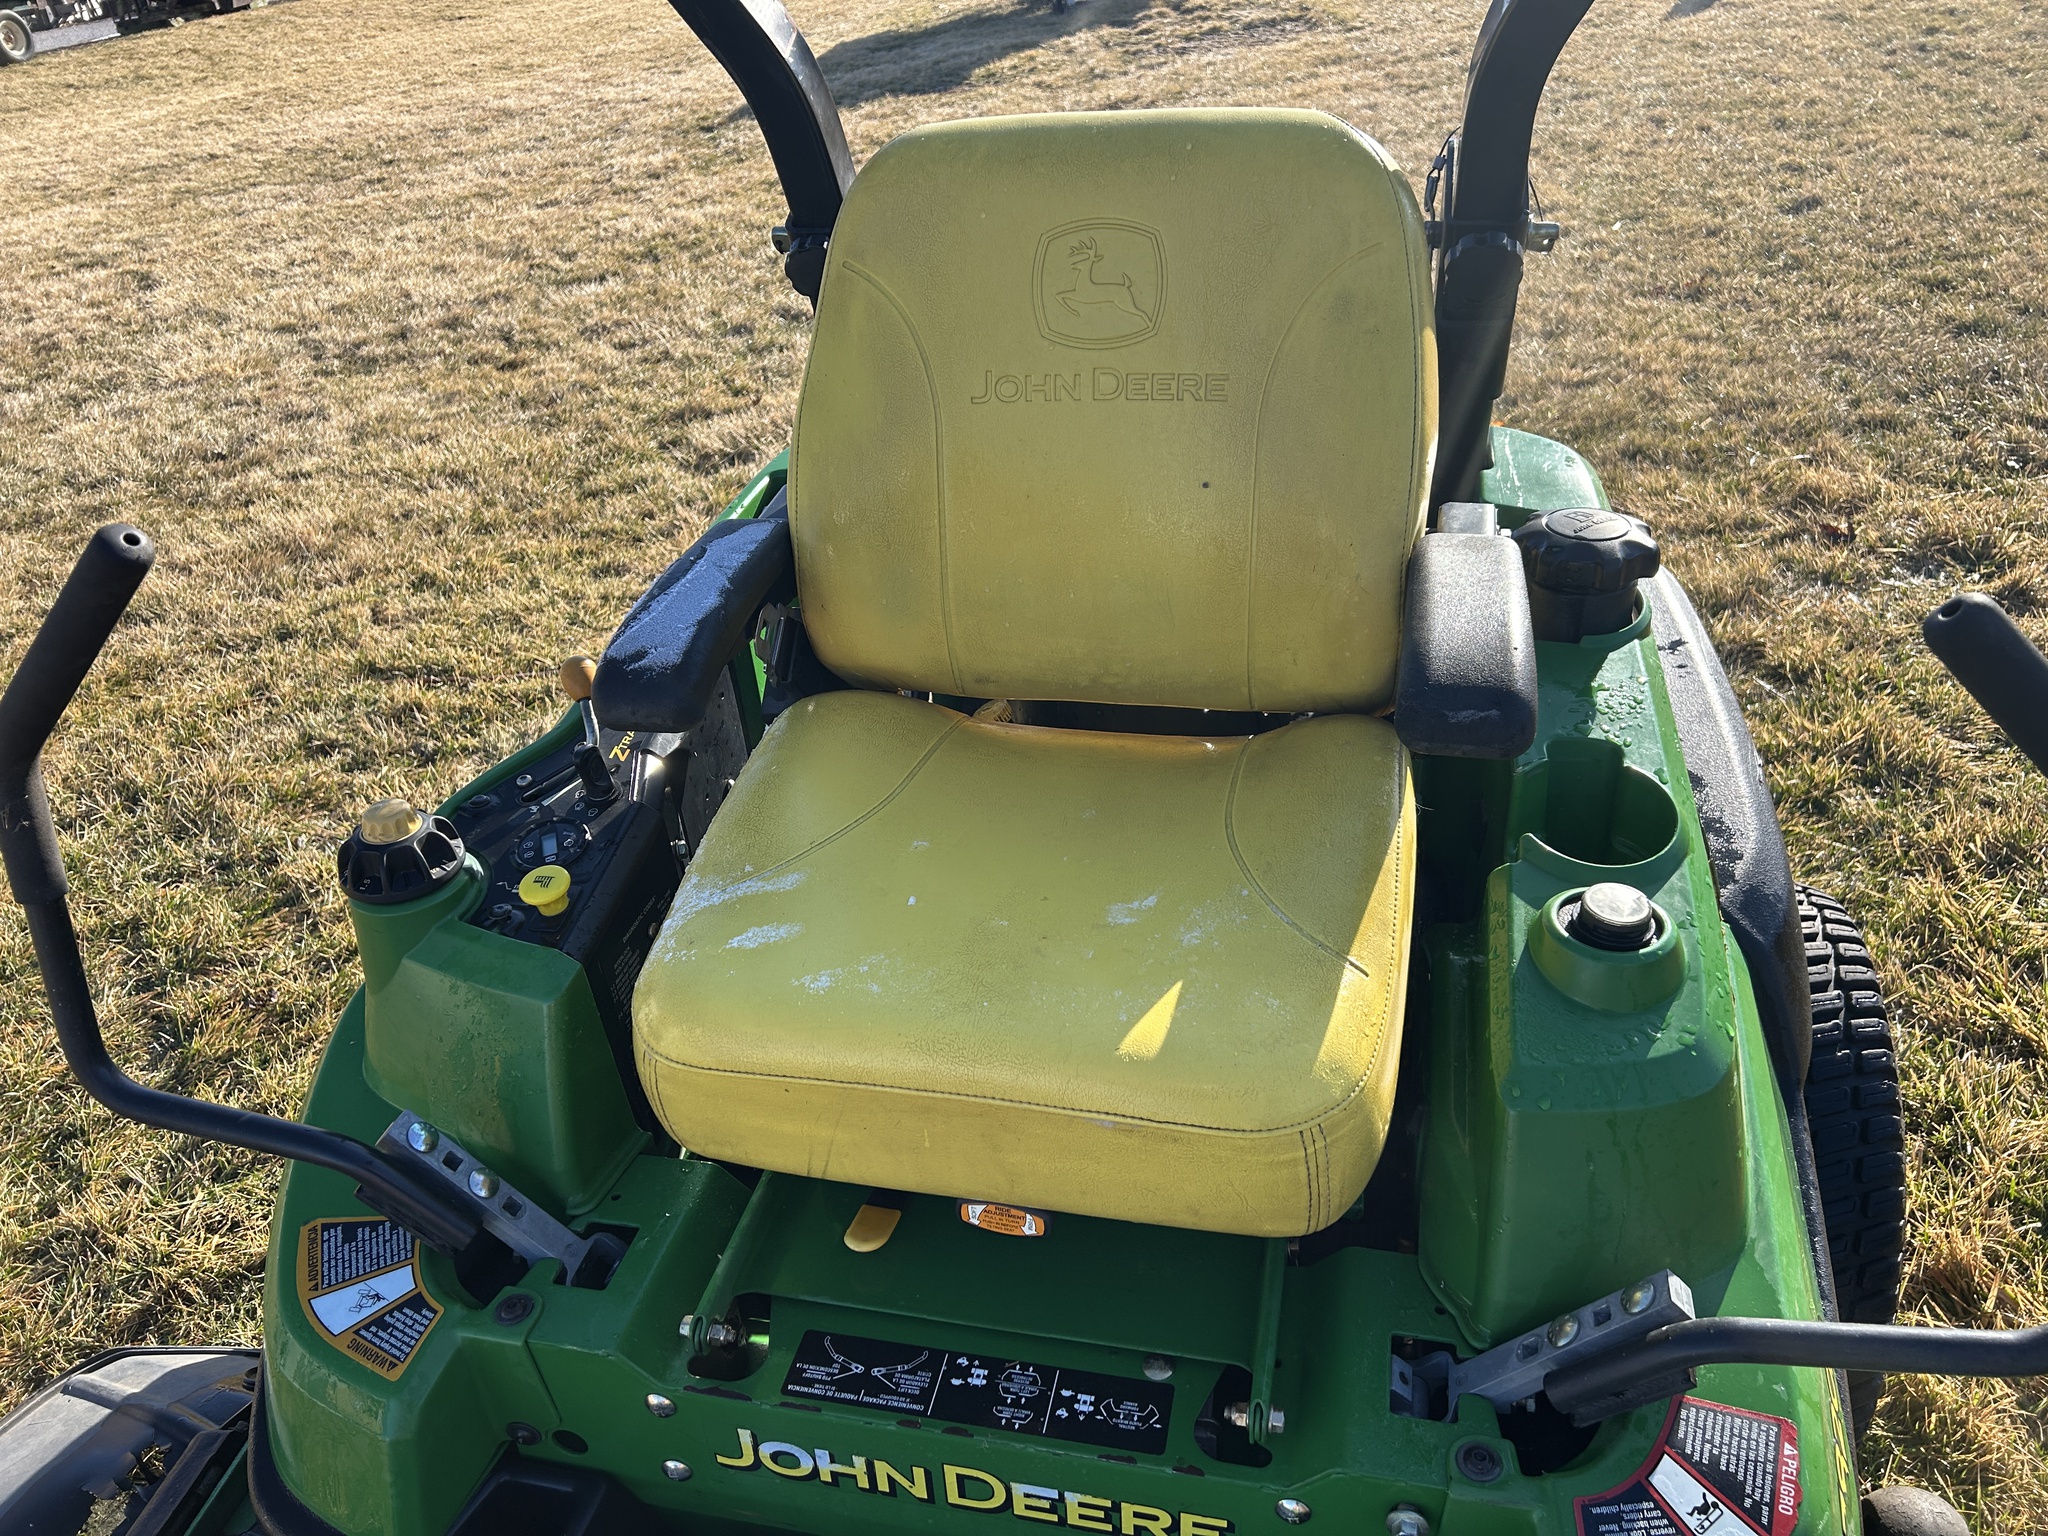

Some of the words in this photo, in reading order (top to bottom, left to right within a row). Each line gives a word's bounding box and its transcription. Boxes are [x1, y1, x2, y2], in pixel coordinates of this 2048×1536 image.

[971, 370, 1081, 404] JOHN
[1093, 367, 1229, 402] DEERE
[609, 731, 635, 762] ZTRA
[984, 1209, 1025, 1221] ADJUSTMENT
[995, 1206, 1011, 1214] RIDE
[308, 1225, 318, 1281] ADVERTENCIA
[347, 1338, 387, 1369] WARNING
[787, 1384, 825, 1395] CONVENIENCIA
[835, 1390, 858, 1400] PAQUETE
[862, 1396, 887, 1405] PACKAGE
[888, 1399, 925, 1411] CONVENIENCE
[1680, 1409, 1688, 1419] los
[1698, 1409, 1706, 1428] llevar
[1685, 1407, 1696, 1454] especialmente
[1714, 1413, 1723, 1447] retroceder
[1723, 1416, 1732, 1444] mientras
[1733, 1417, 1742, 1436] Mirar
[1769, 1425, 1777, 1441] Para
[1693, 1428, 1702, 1461] pasajeros,
[1722, 1444, 1728, 1454] se
[1731, 1436, 1740, 1454] hacia
[1740, 1440, 1747, 1448] en
[1750, 1440, 1756, 1449] en
[1758, 1431, 1766, 1461] segadora
[1767, 1442, 1775, 1461] evitar
[1702, 1443, 1711, 1464] Nunca
[1749, 1450, 1757, 1460] las
[1720, 1454, 1729, 1470] hace
[1737, 1449, 1746, 1481] retroceso.
[1766, 1462, 1774, 1473] las
[715, 1428, 927, 1499] JOHN
[942, 1463, 1230, 1536] DEERE
[1755, 1463, 1763, 1487] cuando
[1753, 1488, 1762, 1501] hay
[1778, 1457, 1798, 1516] PELIGRO
[1590, 1505, 1619, 1514] children.
[1621, 1502, 1654, 1511] especially
[1744, 1497, 1752, 1508] No
[1761, 1506, 1769, 1525] parar
[1622, 1521, 1649, 1529] backing.
[1648, 1527, 1675, 1535] reverse.
